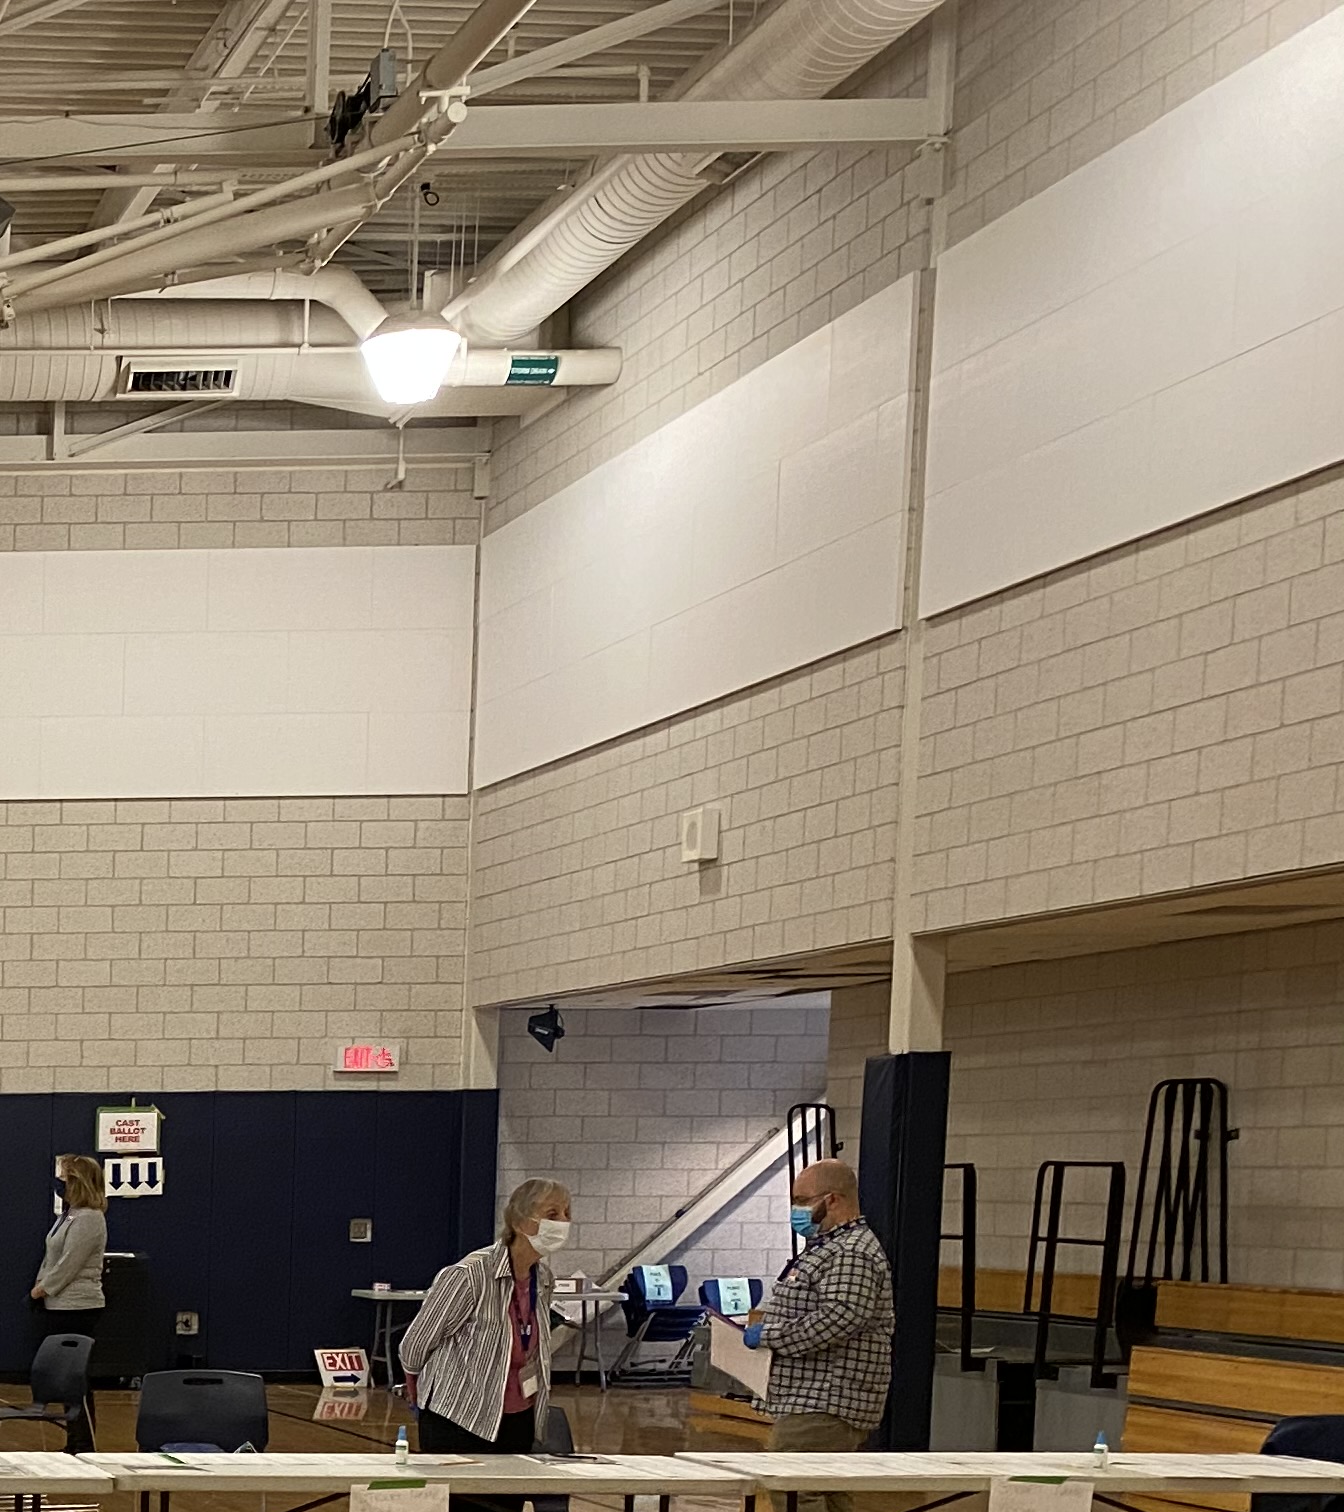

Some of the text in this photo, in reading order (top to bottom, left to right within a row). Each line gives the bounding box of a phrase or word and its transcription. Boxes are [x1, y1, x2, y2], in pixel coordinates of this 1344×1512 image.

[109, 1127, 146, 1135] BALLOT
[115, 1135, 140, 1143] HERE
[322, 1353, 361, 1370] EXIT
